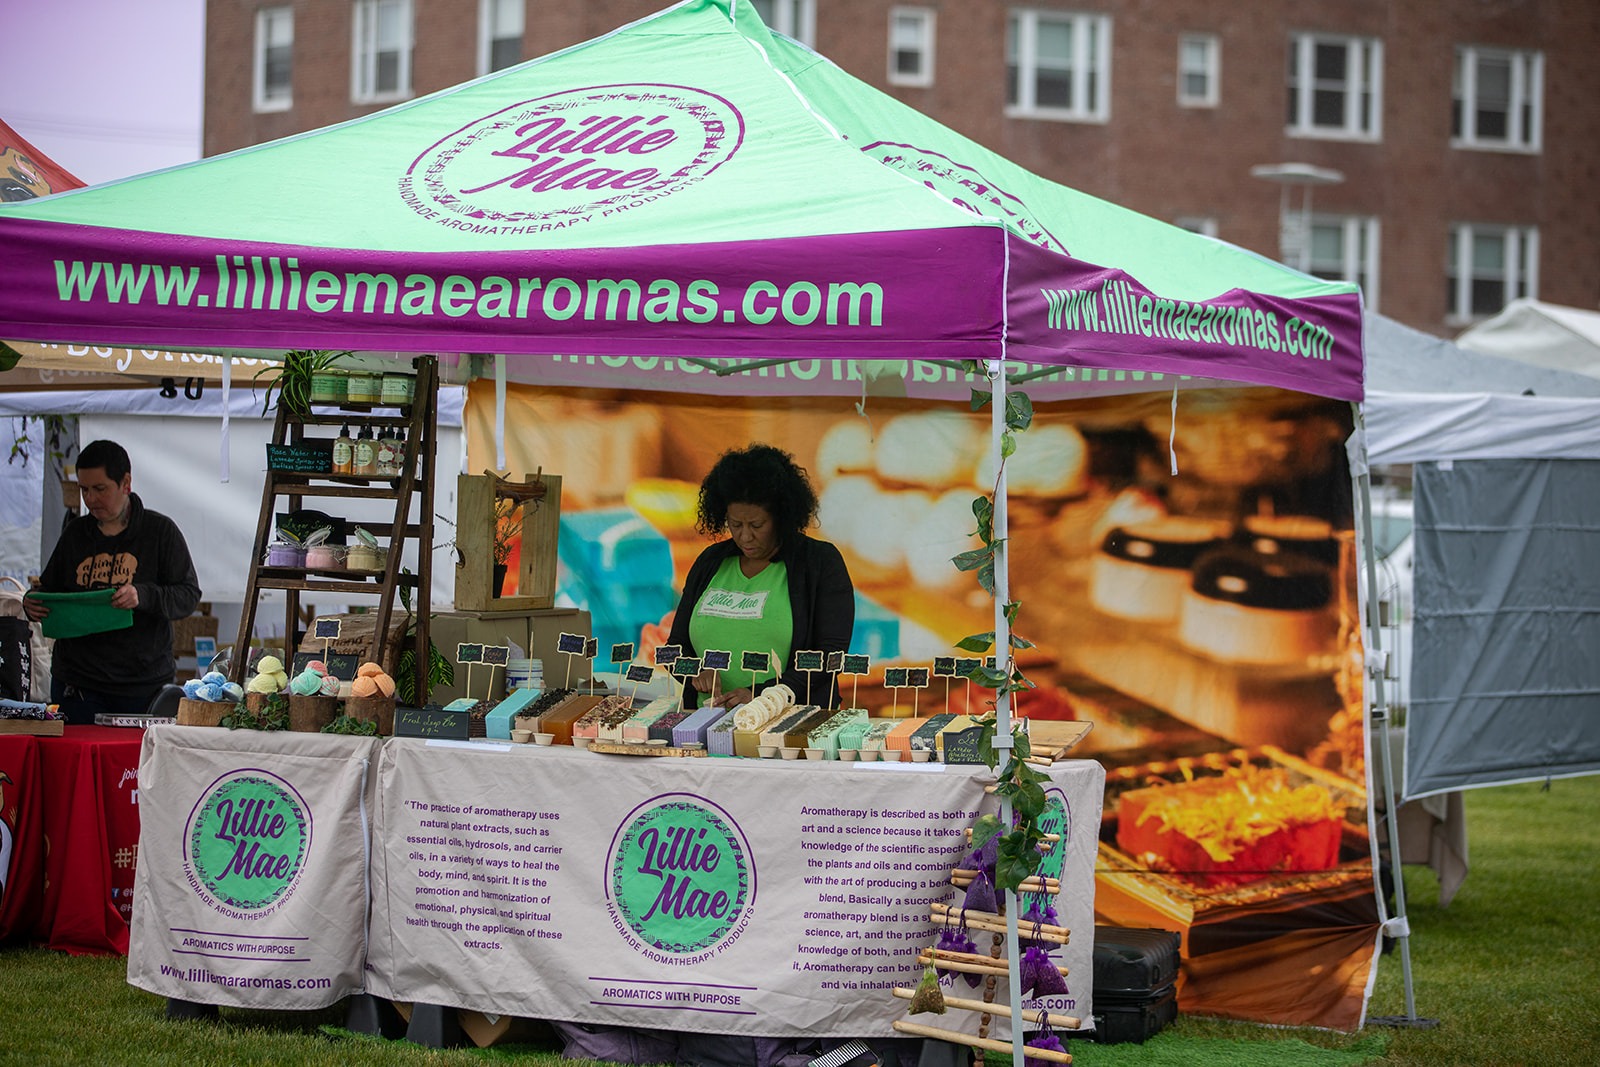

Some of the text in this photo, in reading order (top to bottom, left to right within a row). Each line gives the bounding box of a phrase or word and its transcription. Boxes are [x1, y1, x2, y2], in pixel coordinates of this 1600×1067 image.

[491, 115, 678, 161] Lillie
[460, 158, 661, 193] Mae
[398, 176, 704, 235] HANDMADE AROMATHERAPY PRODUCTS
[53, 255, 883, 327] www.lilliemaearomas.com
[1040, 279, 1335, 361] www.lilliemaearomas.com
[431, 804, 460, 813] practice
[463, 806, 472, 814] of
[475, 808, 537, 820] aromatherapy
[539, 812, 559, 820] uses
[801, 806, 867, 818] Aromatherapy
[870, 808, 878, 818] is
[881, 809, 925, 819] described
[929, 811, 940, 819] as
[943, 811, 965, 819] both
[215, 798, 286, 845] Lillie
[421, 819, 449, 829] natural
[451, 822, 470, 831] plant
[473, 823, 512, 835] extracts,
[515, 827, 537, 835] such
[802, 824, 961, 837] art and a science because it takes
[407, 835, 562, 854] essential oils, hydrosols, and carrier
[637, 826, 721, 881] Lillie
[801, 841, 851, 852] knowledge
[855, 843, 864, 852] of
[866, 843, 879, 852] the
[881, 844, 925, 854] scientific
[928, 844, 965, 855] aspects
[215, 839, 291, 881] Mae
[409, 852, 559, 871] oils, in a variety of ways to heal the
[808, 858, 823, 868] the
[826, 859, 853, 869] plants
[855, 861, 871, 870] and
[874, 861, 890, 870] oils
[894, 861, 911, 871] and
[419, 869, 547, 887] body, mind, and spirit. It is the
[804, 875, 822, 885] with
[825, 876, 839, 886] the
[841, 877, 853, 886] art
[855, 877, 864, 886] of
[867, 878, 917, 890] producing
[920, 879, 926, 888] a
[182, 863, 214, 907] HANDMADE
[214, 905, 275, 920] AROMATHERAPY
[416, 886, 551, 904] promotion and harmonization of
[640, 874, 731, 922] Mae
[819, 893, 846, 904] blend,
[849, 895, 892, 907] Basically
[415, 903, 457, 914] emotional,
[500, 909, 512, 918] and
[515, 912, 551, 921] spiritual
[804, 911, 931, 924] aromatherapy blend is a sy
[406, 916, 562, 939] health through the application of these
[606, 902, 754, 966] HANDMADE AROMATHERAPY PRODUCTS
[805, 928, 843, 939] science,
[846, 930, 861, 940] art,
[865, 930, 882, 939] and
[886, 930, 901, 939] the
[182, 938, 295, 954] AROMATICS WITH PURPOSE
[464, 939, 502, 949] extracts.
[798, 944, 848, 956] knowledge
[851, 946, 861, 955] of
[864, 946, 890, 957] both,
[893, 945, 911, 956] and
[793, 961, 801, 971] it,
[803, 962, 873, 974] Aromatherapy
[877, 964, 895, 973] can
[898, 963, 910, 972] be
[821, 979, 839, 989] and
[843, 979, 857, 989] via
[603, 988, 740, 1005] AROMATICS WITH PURPOSE
